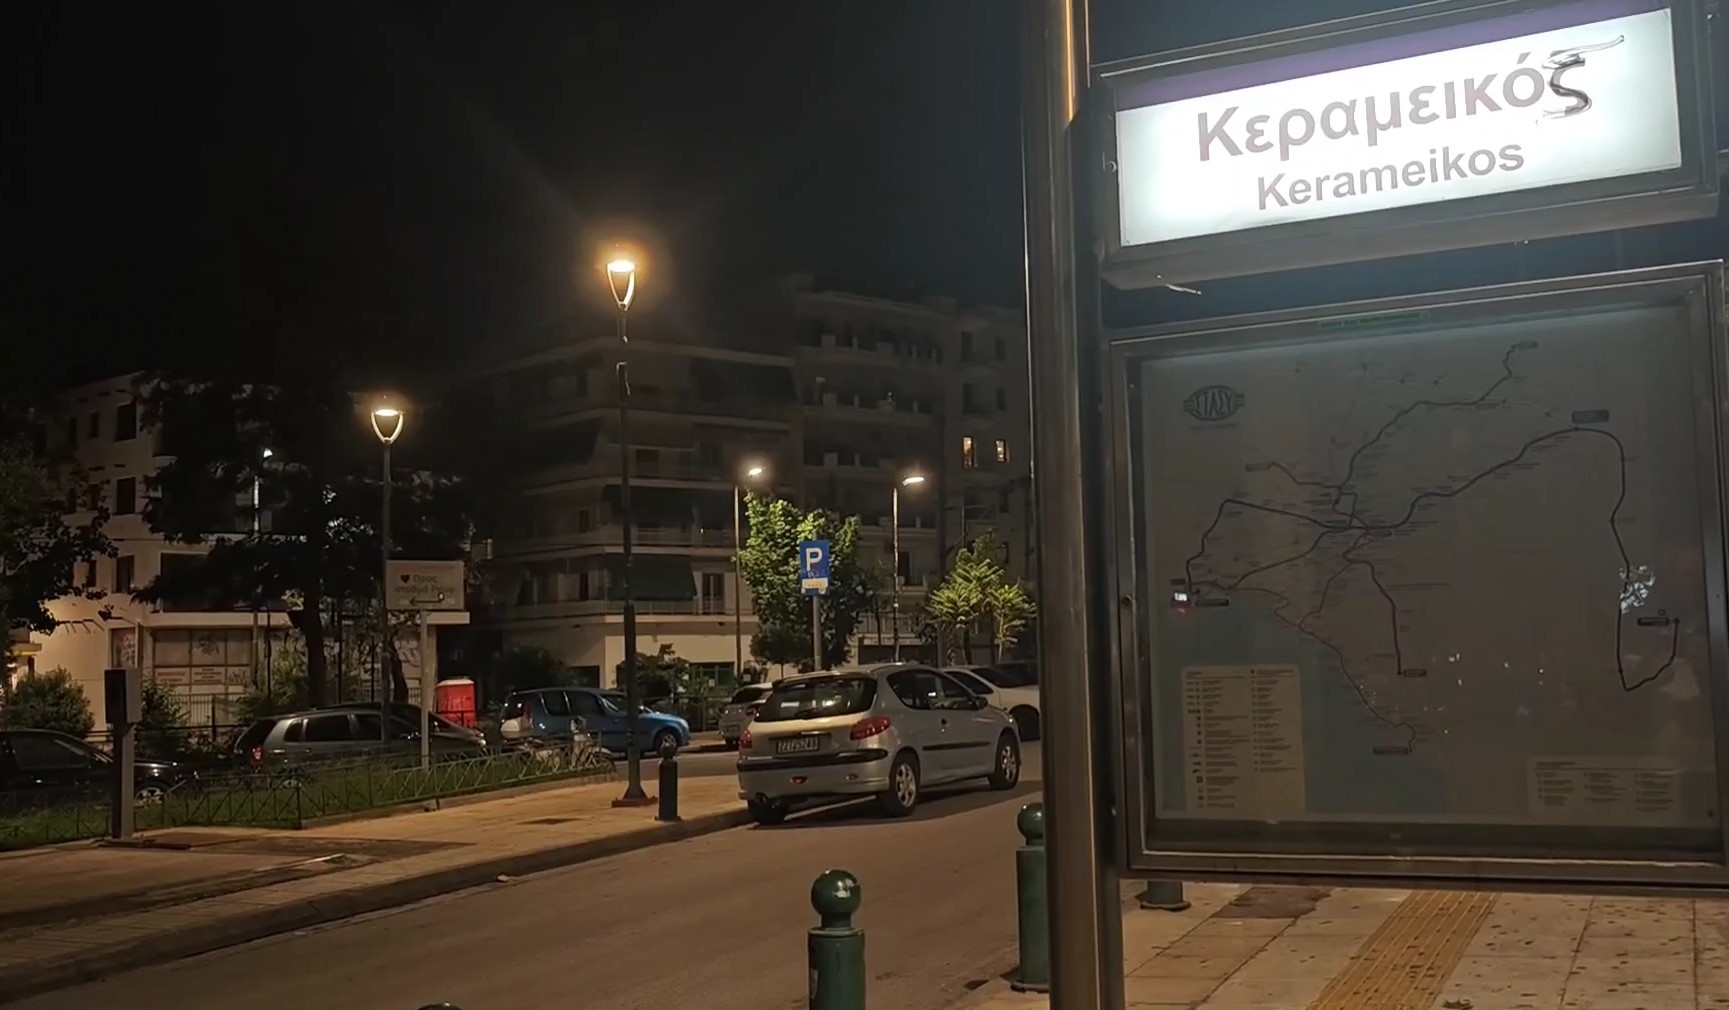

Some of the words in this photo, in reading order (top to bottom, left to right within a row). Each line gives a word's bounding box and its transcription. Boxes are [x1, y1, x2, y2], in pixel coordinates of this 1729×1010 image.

[1198, 51, 1592, 162] Κεραμεικός
[1257, 143, 1525, 210] Kerameikos
[806, 547, 822, 571] P
